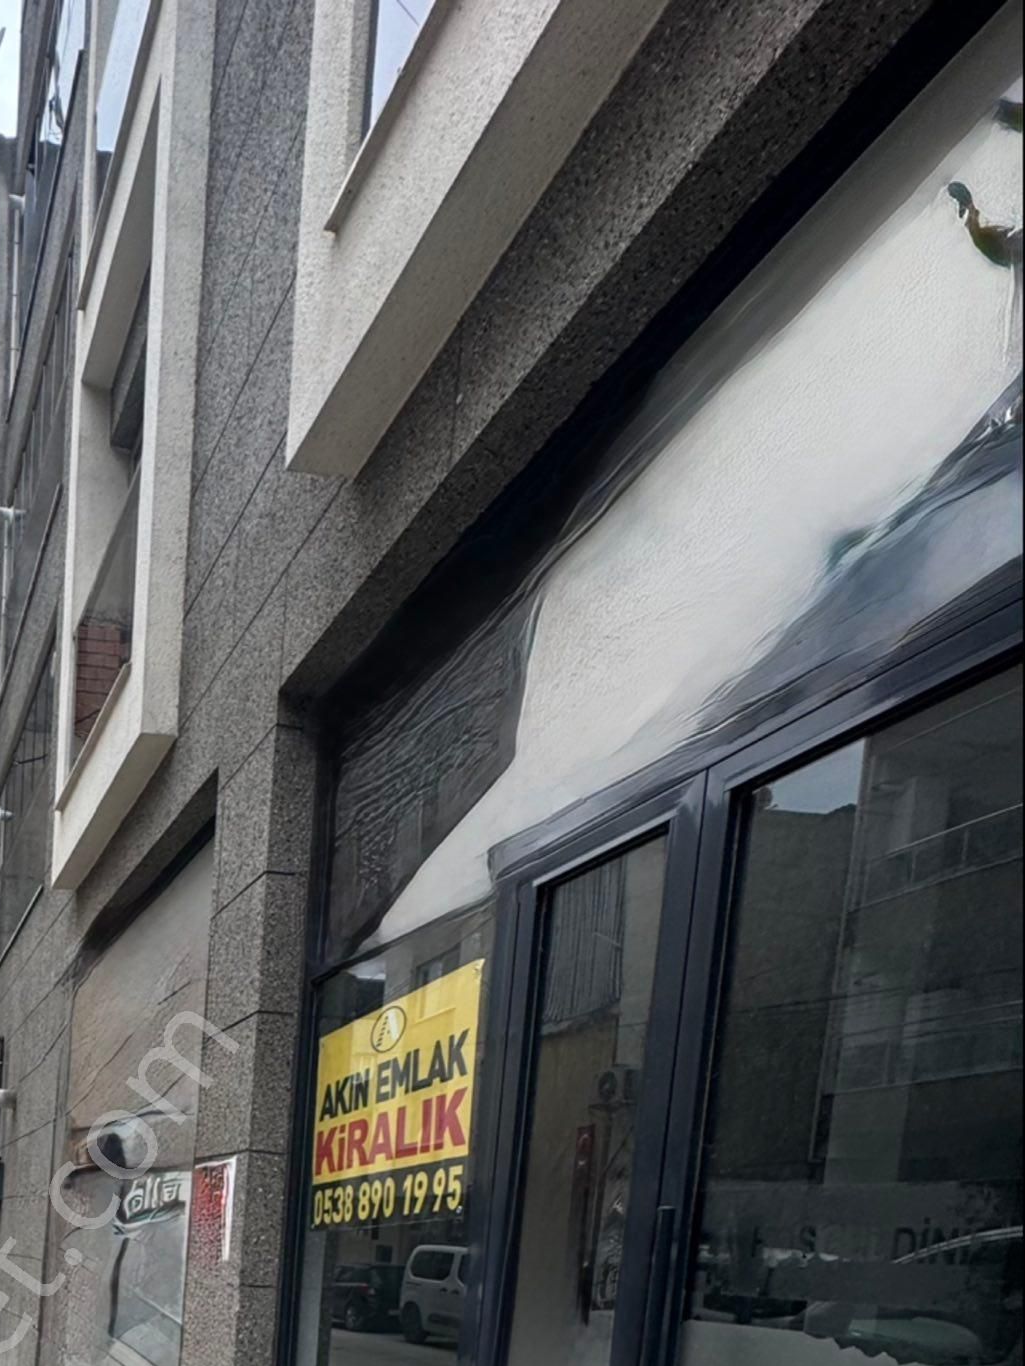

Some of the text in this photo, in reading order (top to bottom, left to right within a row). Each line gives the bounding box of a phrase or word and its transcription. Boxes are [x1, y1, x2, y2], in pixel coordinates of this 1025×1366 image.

[375, 1028, 470, 1103] EMLAK
[315, 1087, 468, 1176] KİRALIK
[314, 1165, 463, 1226] 0538 890 19 95
